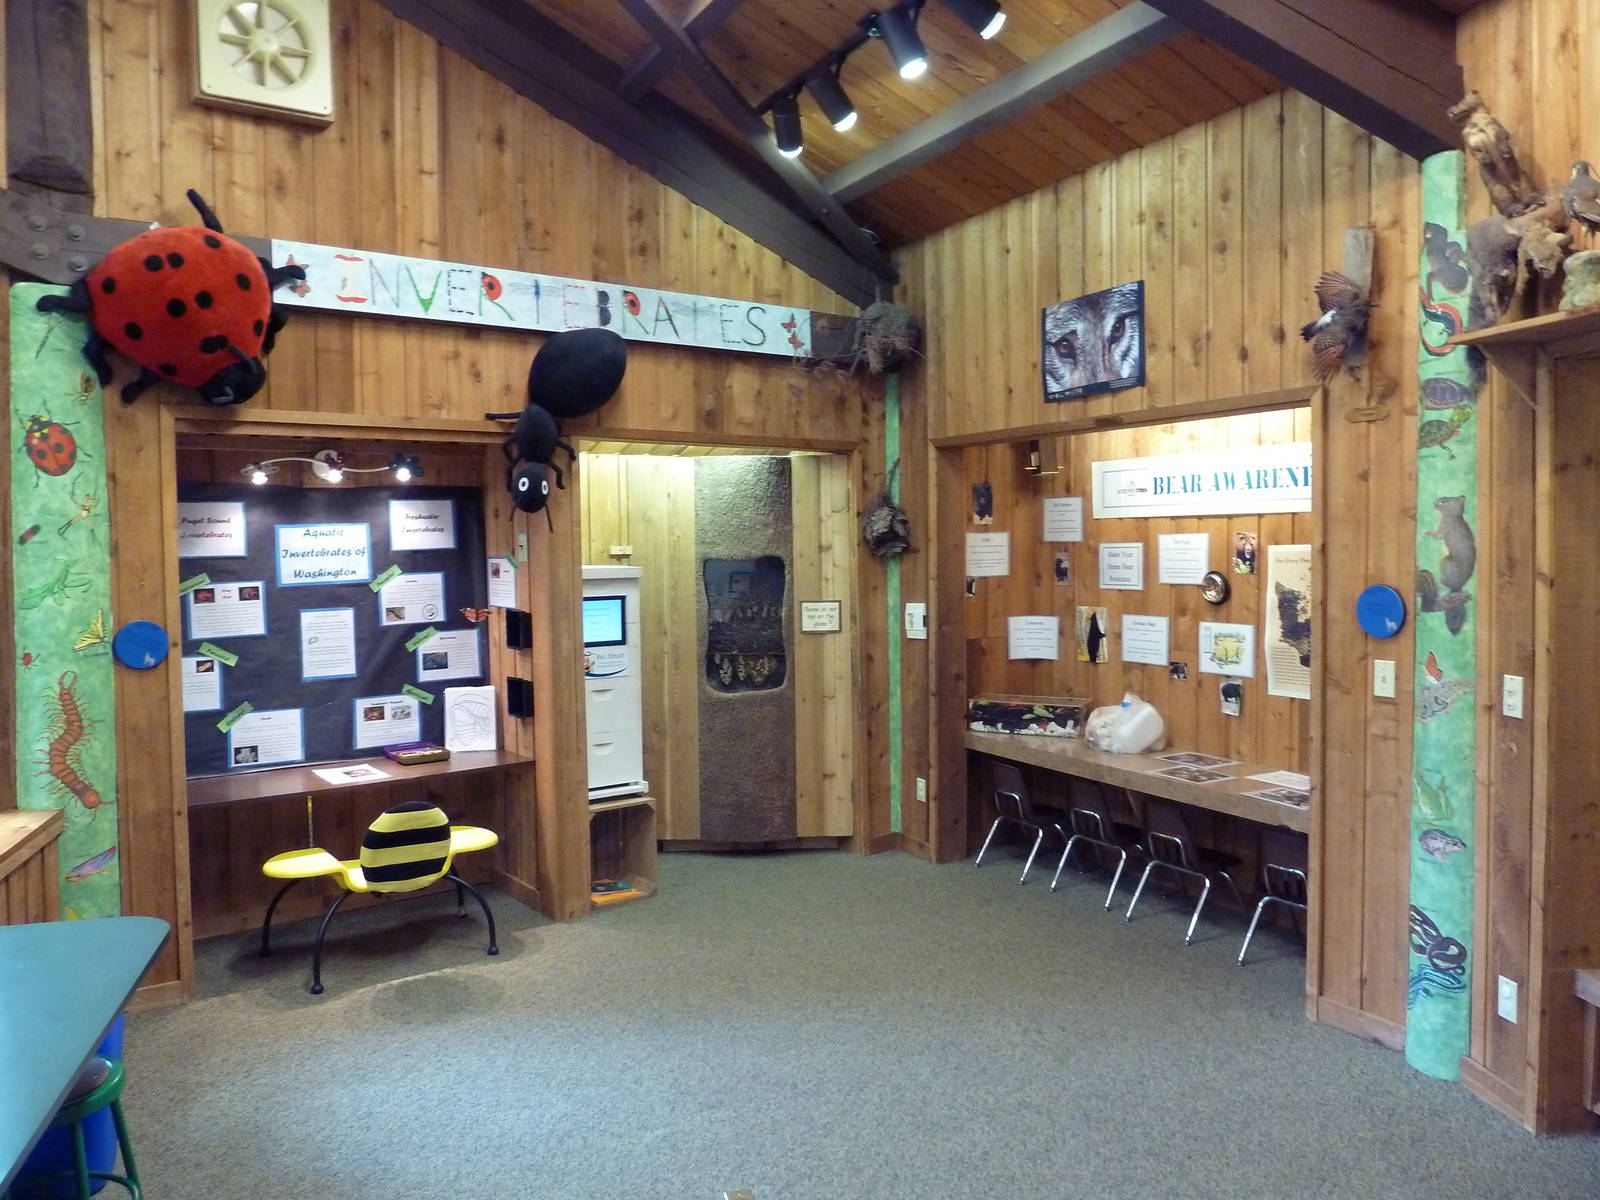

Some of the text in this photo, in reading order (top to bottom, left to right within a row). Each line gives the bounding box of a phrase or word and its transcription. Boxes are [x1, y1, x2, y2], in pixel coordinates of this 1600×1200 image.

[334, 253, 768, 347] INVERTEBRATES
[1153, 473, 1203, 496] BEAR
[206, 516, 231, 525] Sound
[303, 528, 345, 539] Aquatic
[281, 546, 366, 559] Invertebrates of
[293, 567, 357, 579] Washington
